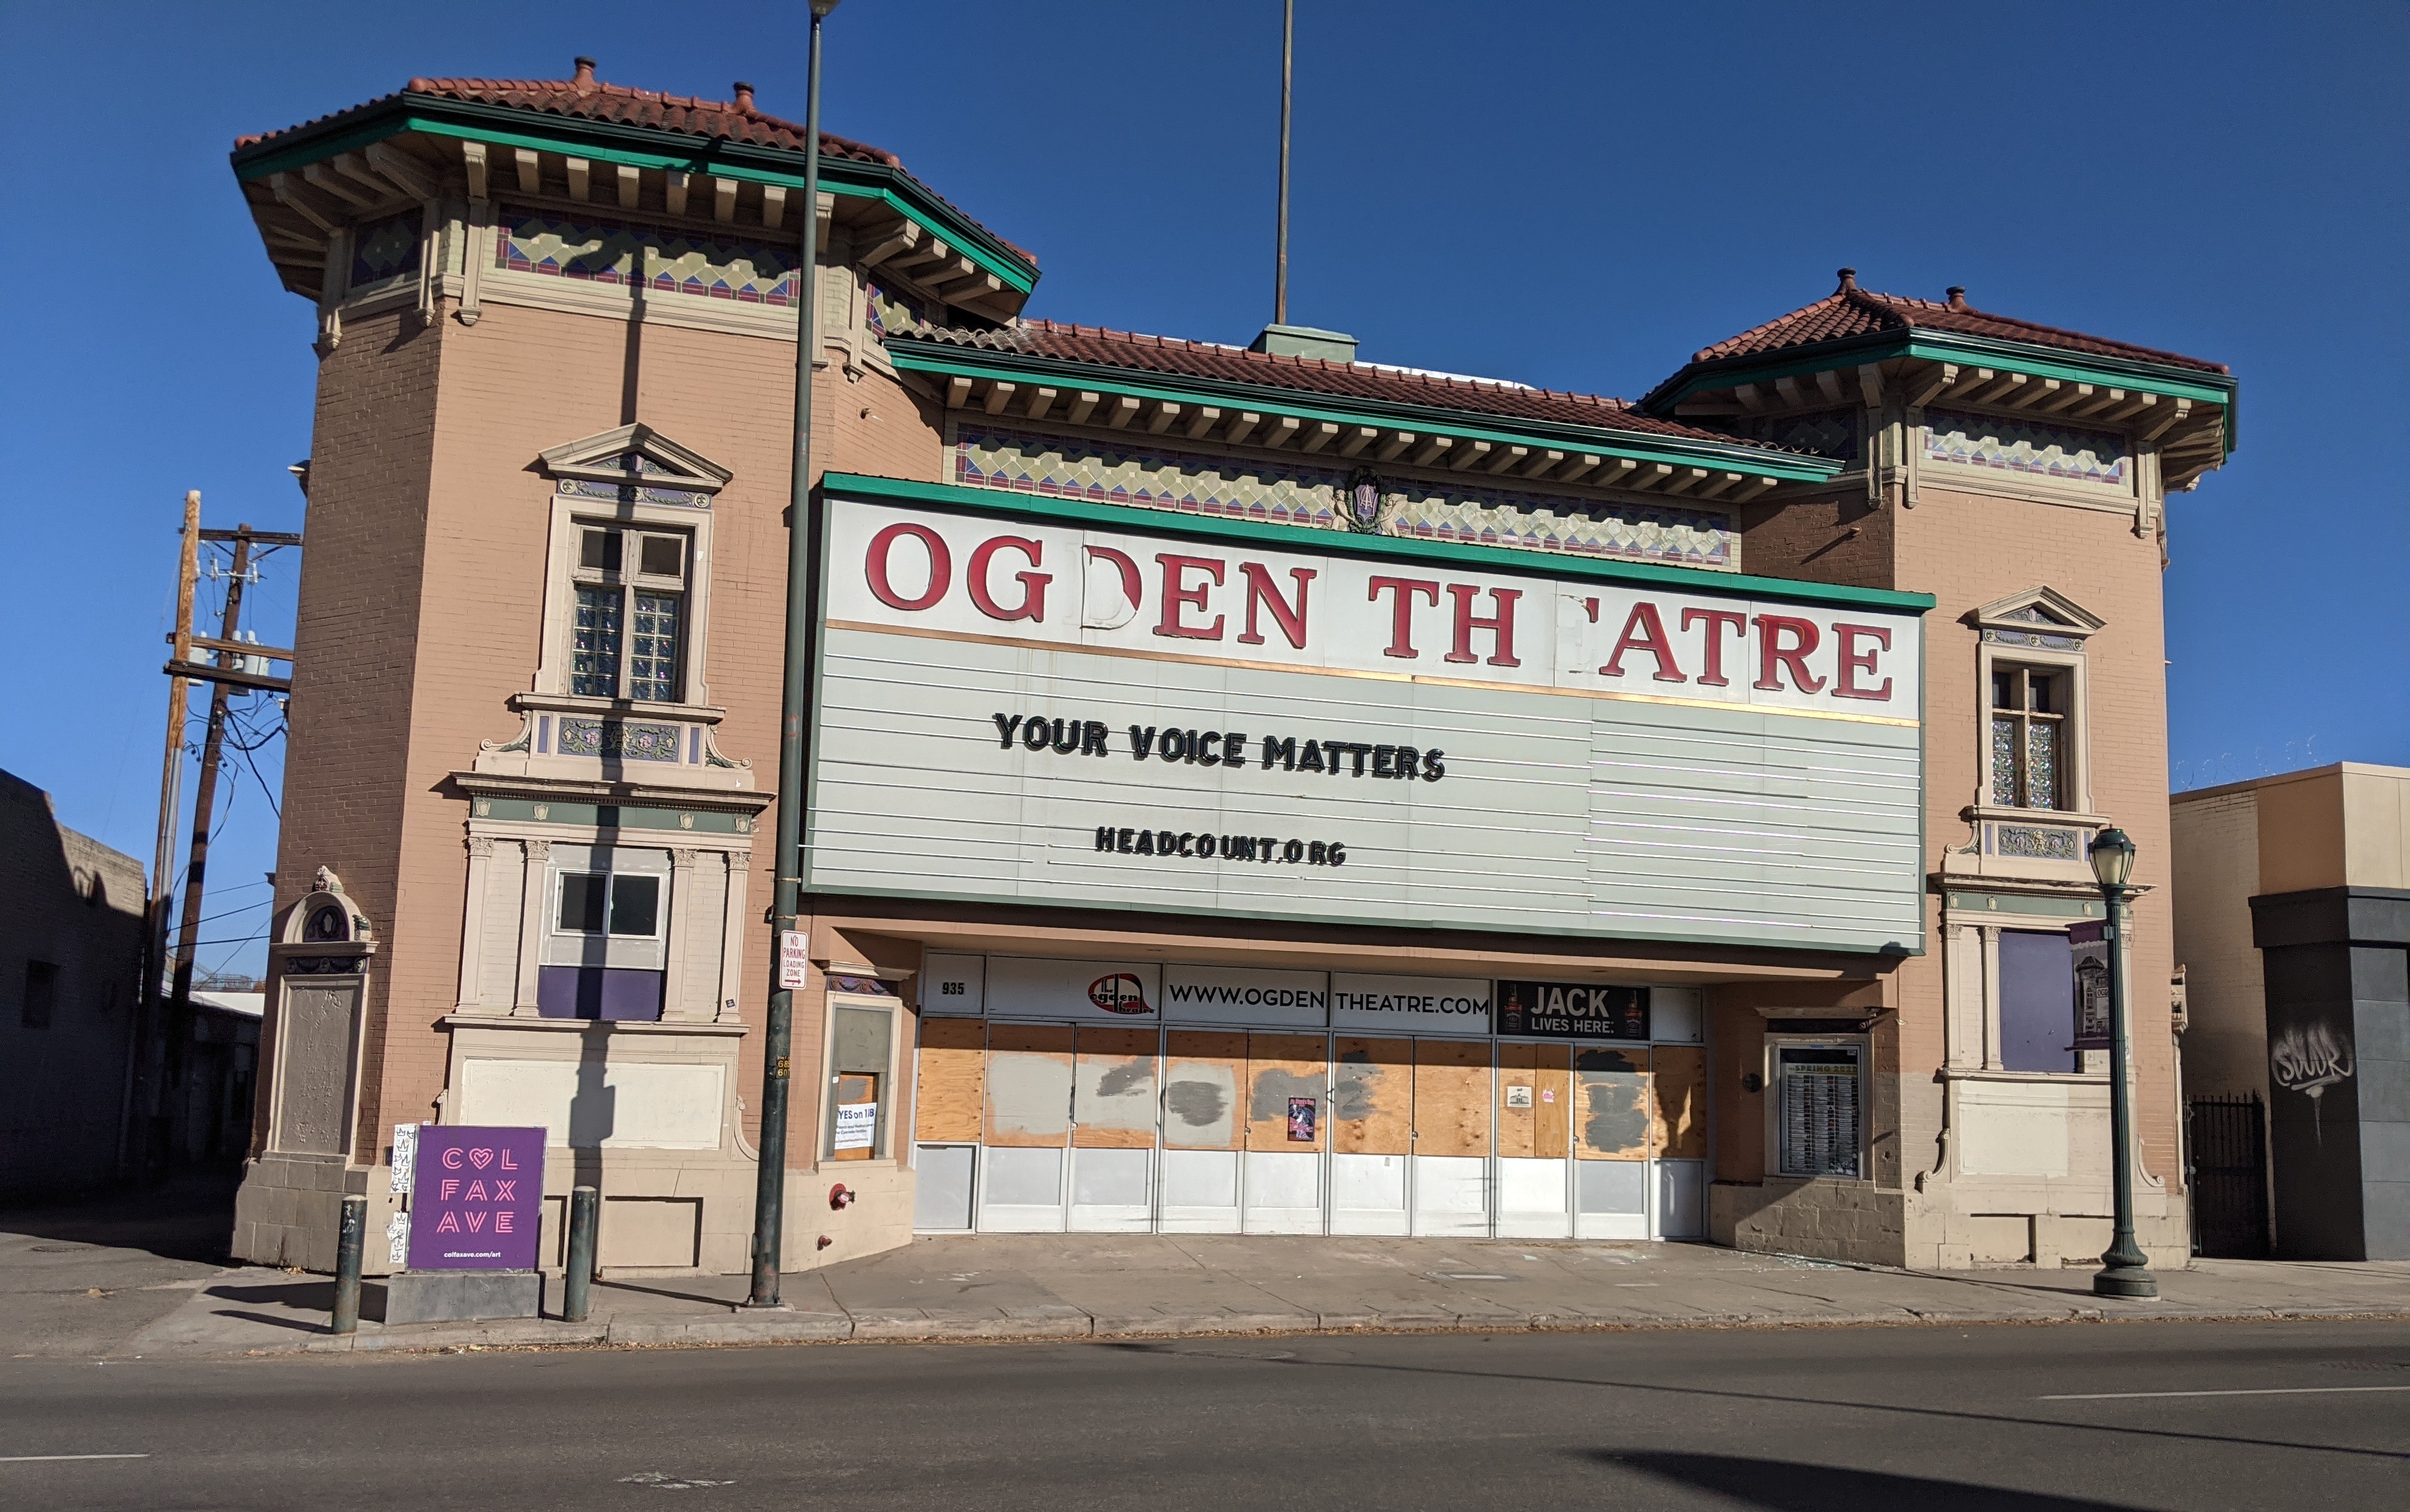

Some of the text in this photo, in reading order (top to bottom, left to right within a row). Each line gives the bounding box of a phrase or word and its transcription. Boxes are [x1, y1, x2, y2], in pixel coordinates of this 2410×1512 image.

[1368, 576, 1892, 701] THATRE
[995, 713, 1445, 781] YOUR VOICE MATTERS
[1097, 827, 1346, 865] HEADCOUNT.ORG
[790, 936, 799, 947] NO
[783, 947, 805, 960] PARKING
[783, 960, 805, 968] LOADING
[786, 969, 801, 977] ZONE
[943, 982, 964, 995] 935
[1530, 986, 1610, 1018] JACK
[1531, 1017, 1570, 1032] LIVES
[839, 1110, 853, 1119] YES
[441, 1179, 516, 1201] FAX
[436, 1211, 514, 1233] AVE
